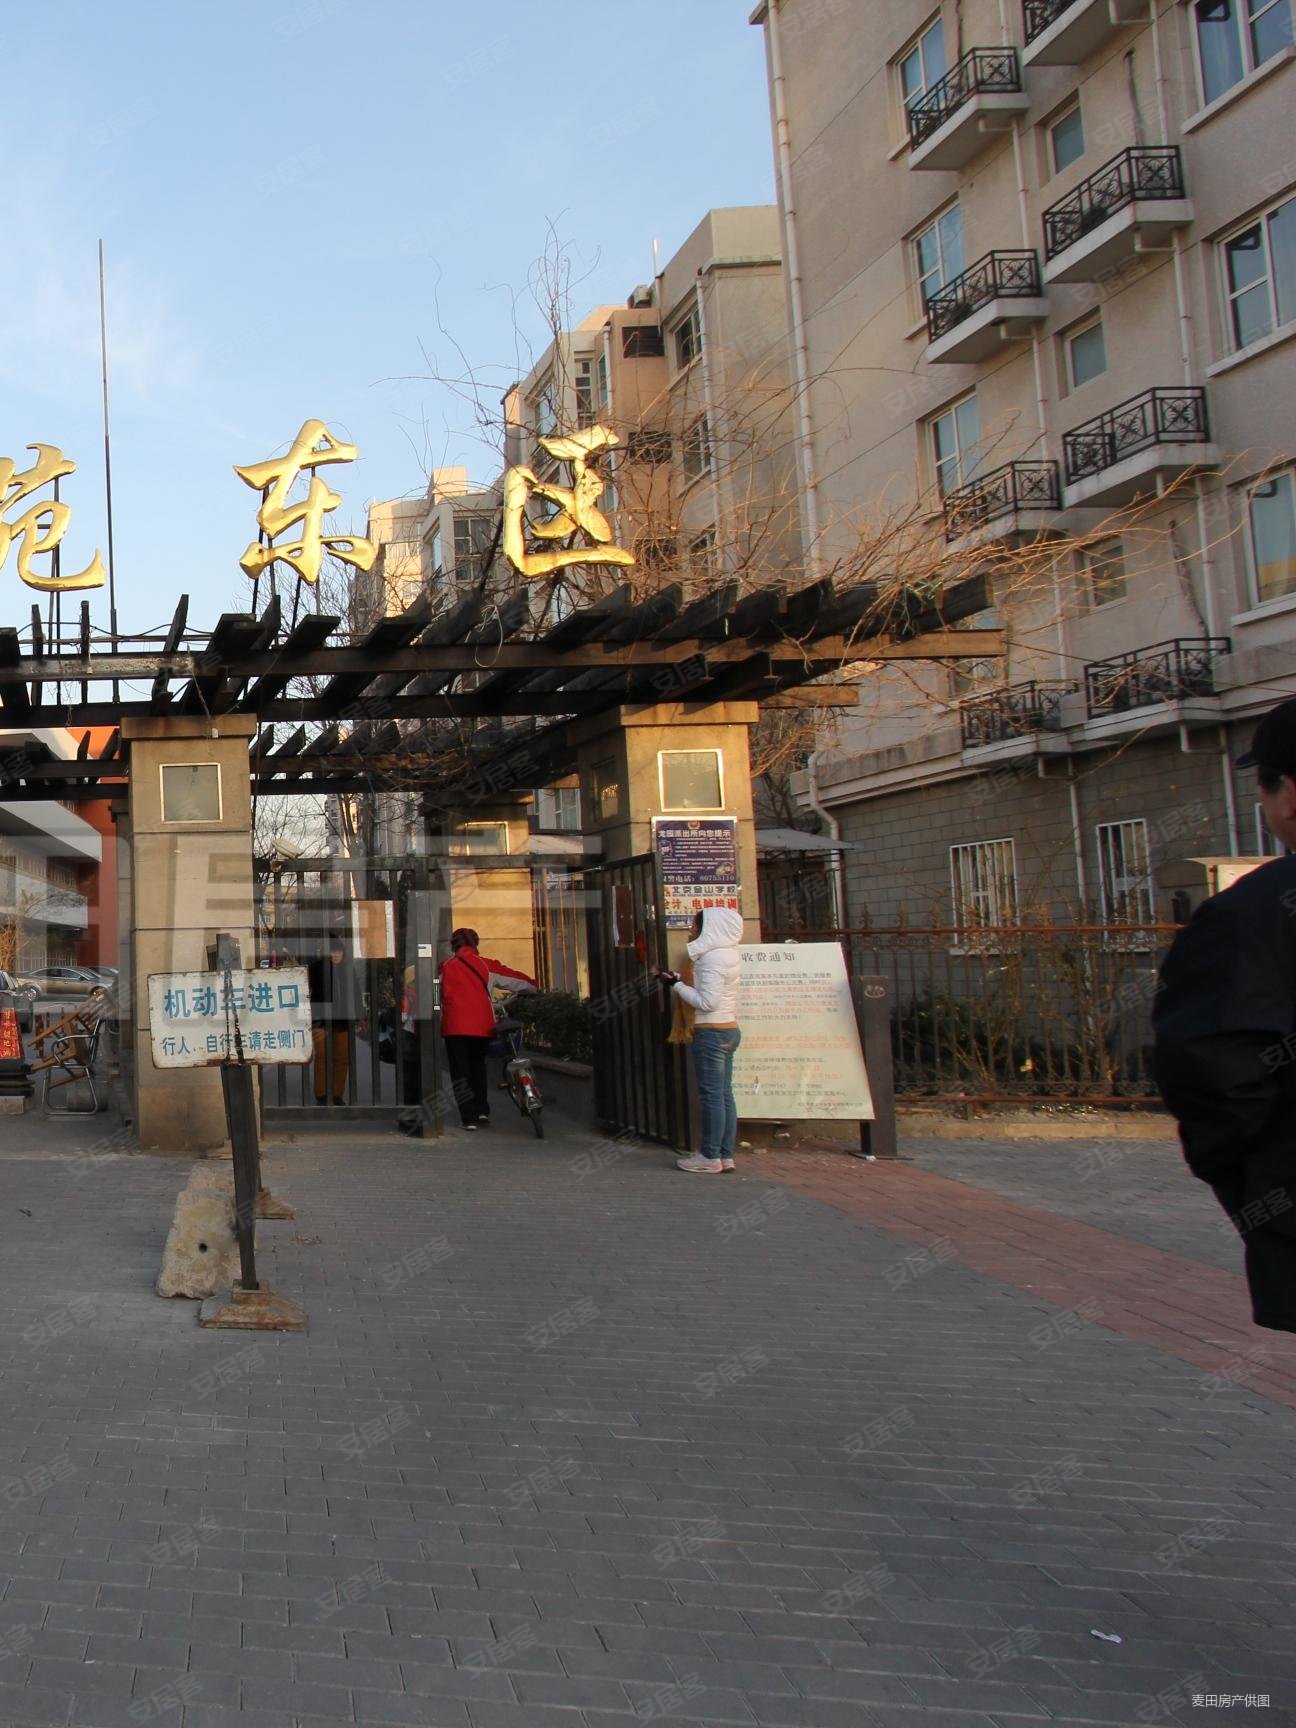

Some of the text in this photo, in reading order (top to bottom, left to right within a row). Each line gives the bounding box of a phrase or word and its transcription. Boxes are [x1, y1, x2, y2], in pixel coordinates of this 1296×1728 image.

[163, 982, 300, 1019] 机动车进口
